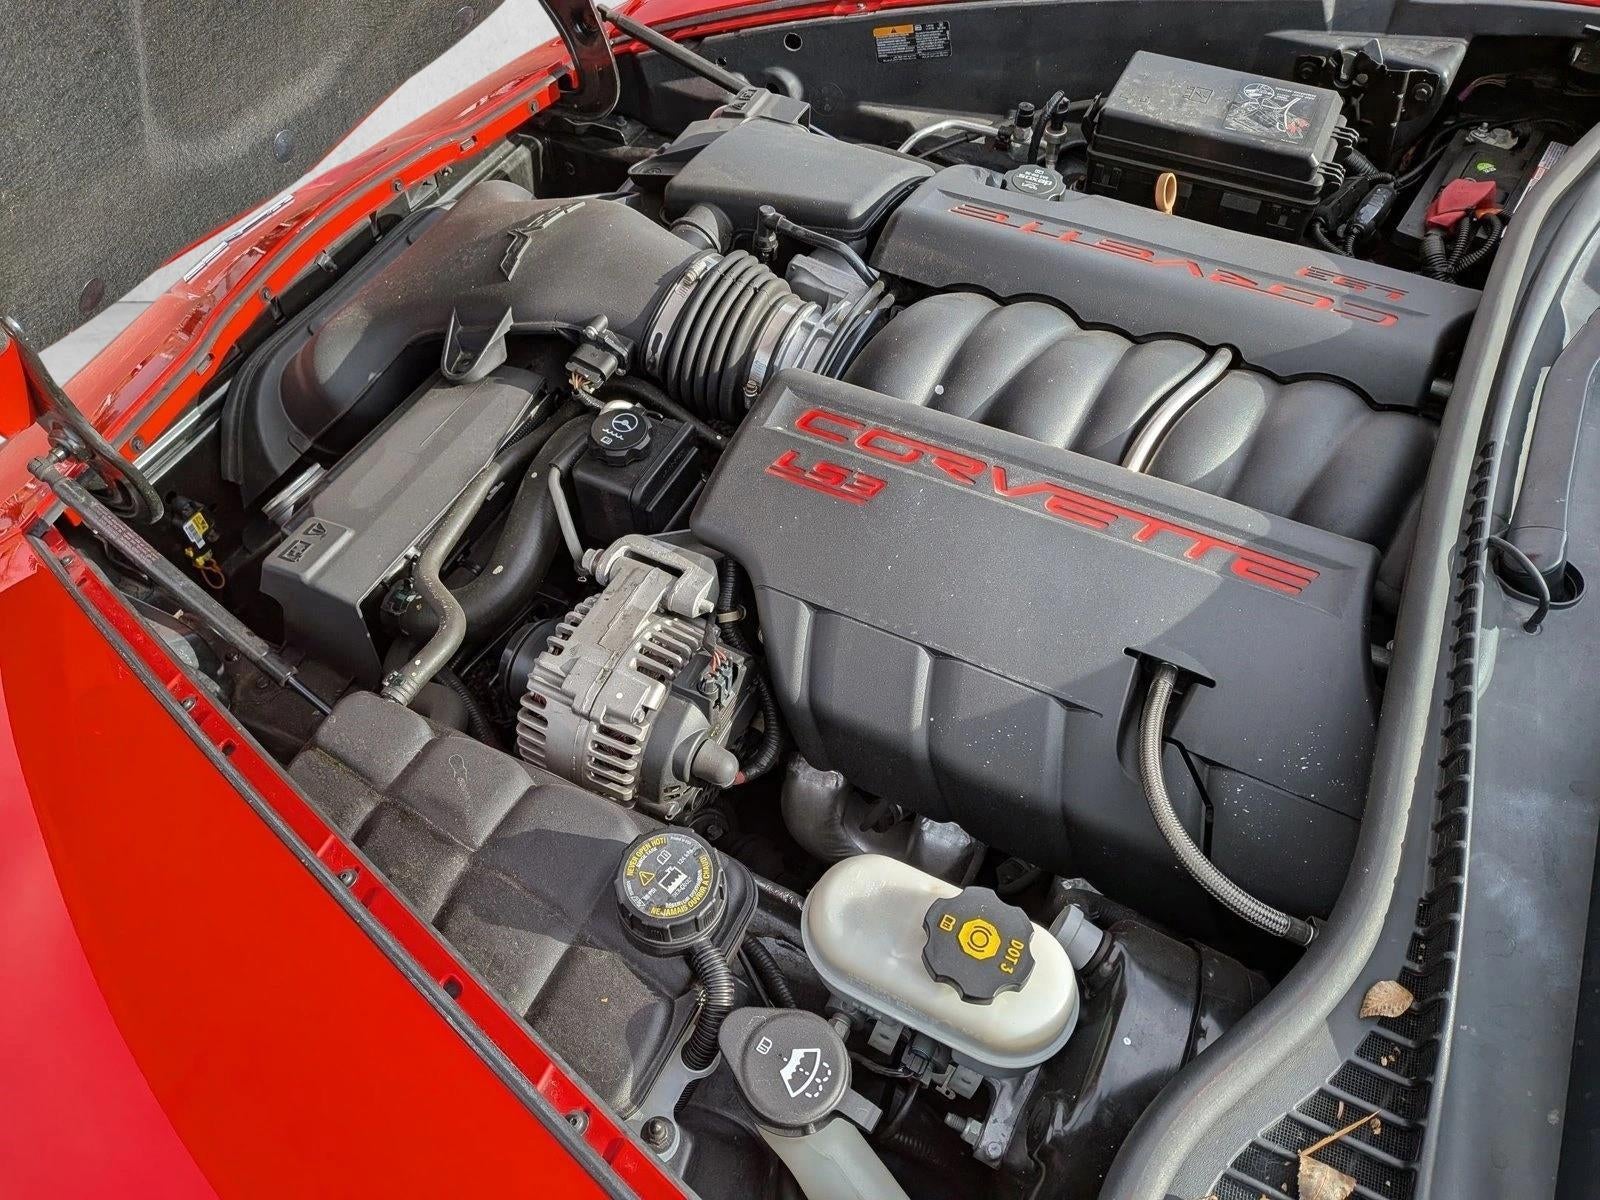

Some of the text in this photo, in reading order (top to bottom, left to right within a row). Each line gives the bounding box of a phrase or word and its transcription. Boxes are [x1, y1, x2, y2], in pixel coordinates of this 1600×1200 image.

[1018, 173, 1053, 186] dexos
[949, 204, 1399, 327] CORVETTE
[1297, 265, 1410, 300] LS3
[765, 450, 888, 505] LS3
[795, 409, 1320, 595] CORVETTE
[627, 859, 637, 876] NEVER
[636, 843, 651, 857] OPEN
[651, 837, 667, 847] HOT!
[650, 907, 661, 915] NE
[660, 904, 688, 916] JAMAIS
[688, 886, 706, 908] OUVRIR
[1000, 939, 1024, 974] DOT 3
